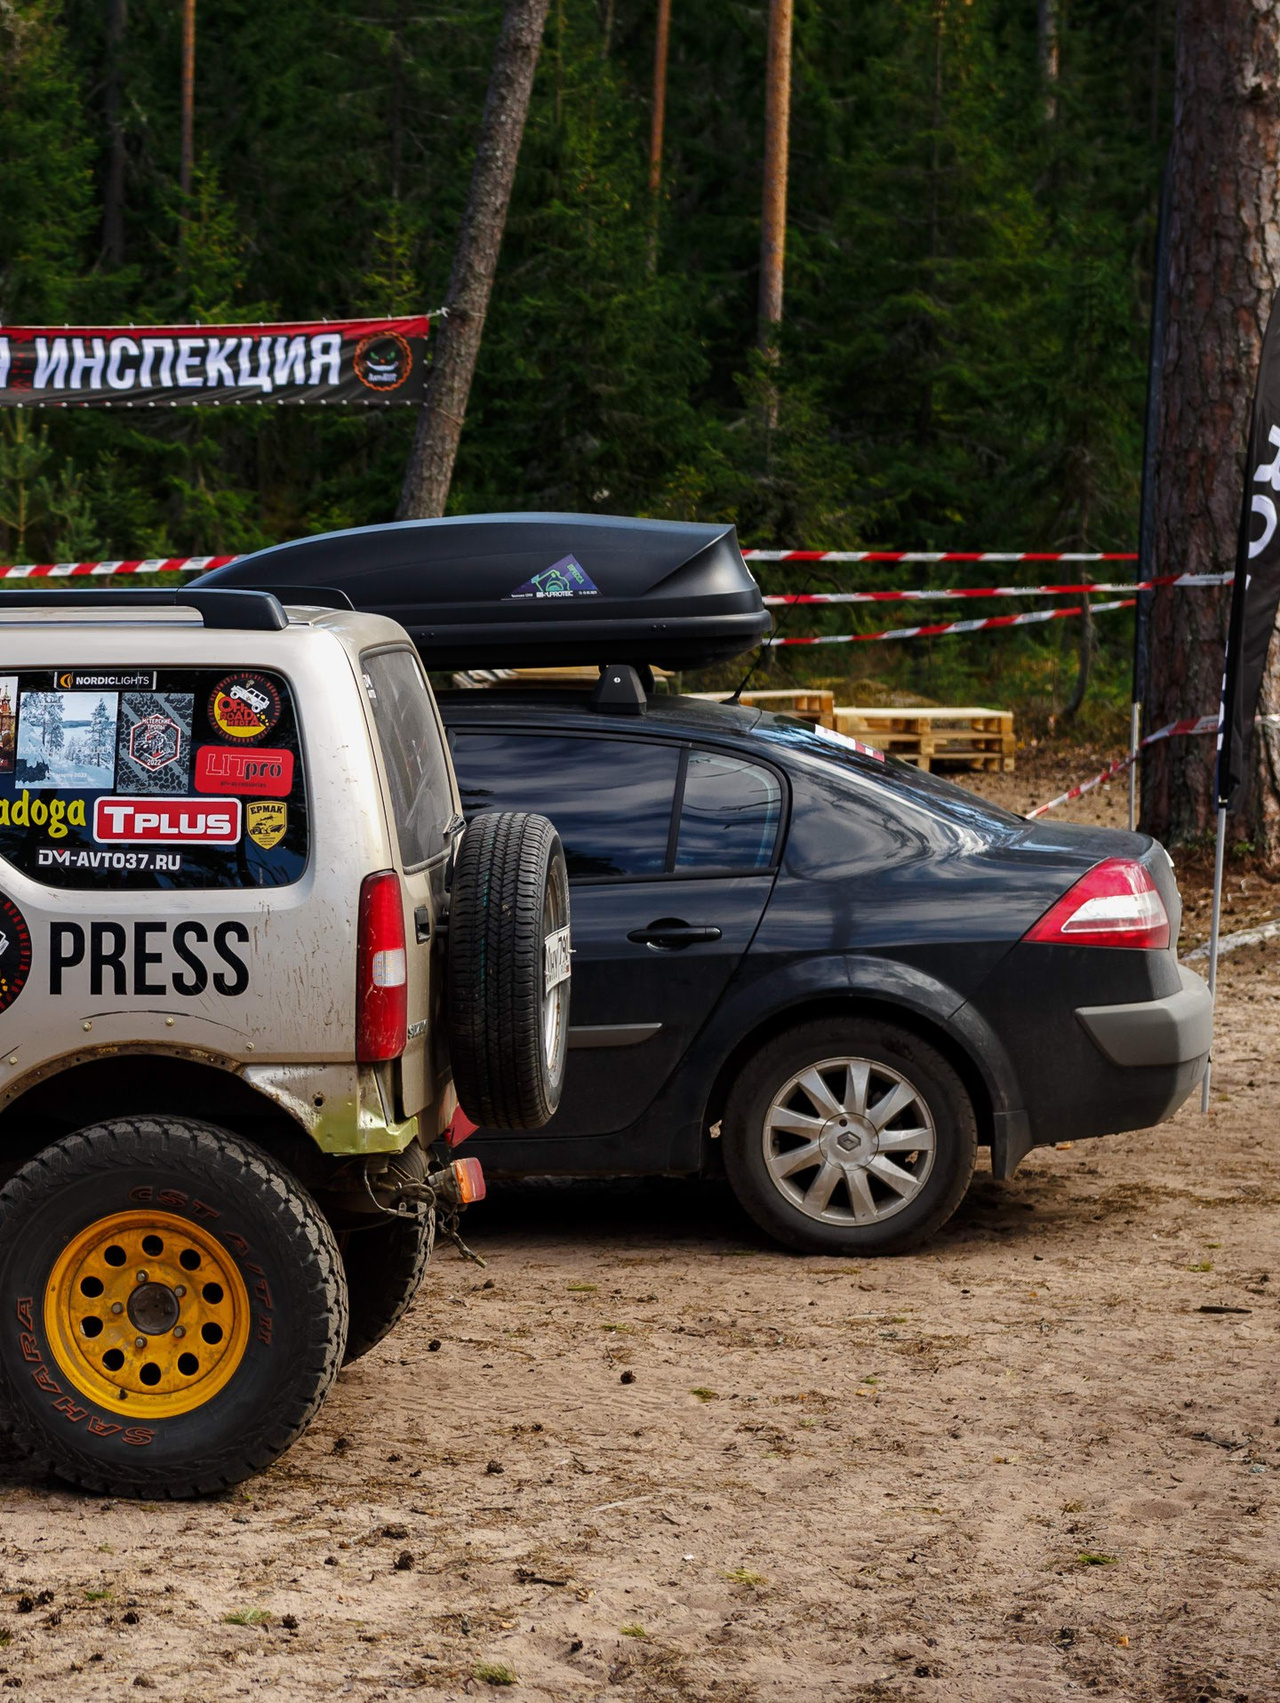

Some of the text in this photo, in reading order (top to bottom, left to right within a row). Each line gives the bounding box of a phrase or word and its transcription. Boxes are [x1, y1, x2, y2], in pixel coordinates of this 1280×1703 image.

[32, 333, 341, 392] ИНСПЕКЦИЯ
[75, 676, 149, 685] NORDICLIGHTS
[104, 806, 232, 835] TPLUS
[249, 804, 284, 815] ЕРМАК
[49, 920, 251, 997] PRESS
[127, 1185, 220, 1219] CST
[16, 1297, 156, 1447] SAHARA
